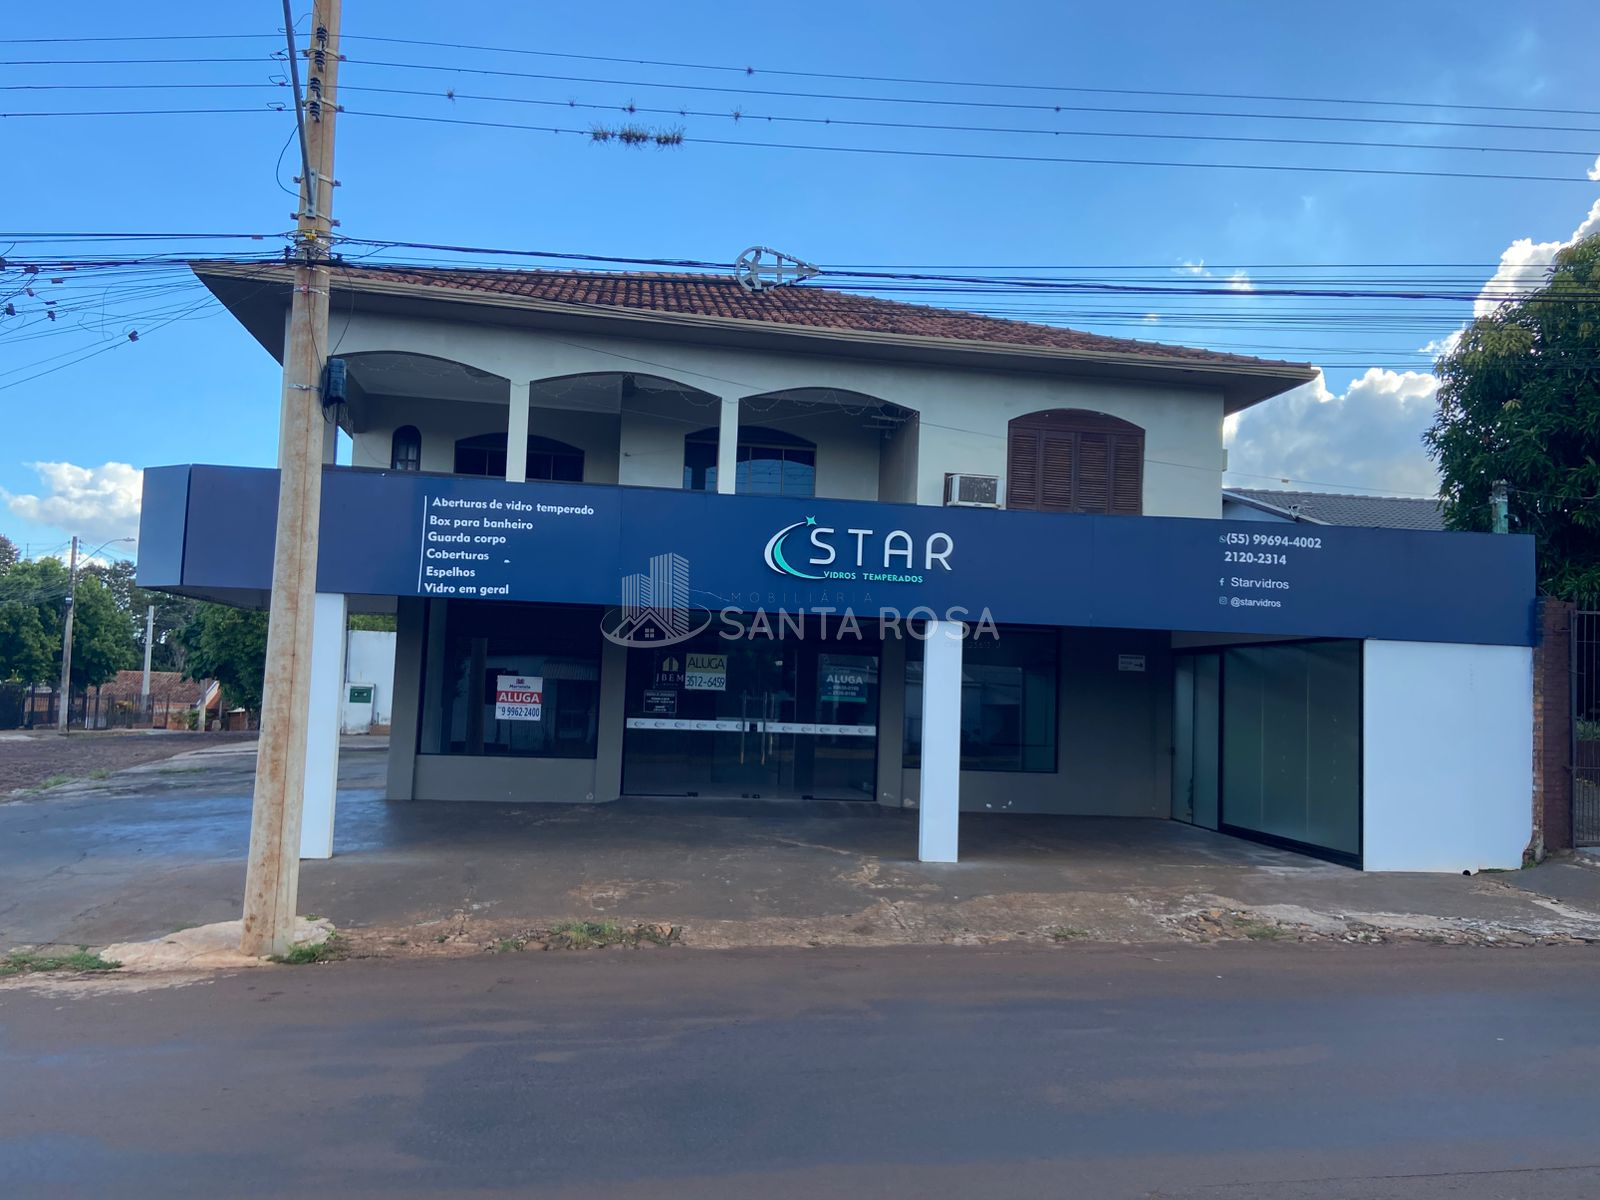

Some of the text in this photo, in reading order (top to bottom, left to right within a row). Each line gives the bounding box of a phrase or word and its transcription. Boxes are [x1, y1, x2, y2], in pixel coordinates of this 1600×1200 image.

[432, 497, 595, 515] Aberturas de vidro temperado
[430, 515, 534, 530] Box para banheiro
[427, 532, 507, 546] Guarda corpo
[1226, 533, 1322, 549] (55) 99694-4002
[426, 548, 490, 560] Coberturas
[809, 528, 955, 572] STAR
[1224, 551, 1287, 565] 2120-2314
[425, 566, 476, 578] Espelhos
[823, 571, 924, 584] VIDROS TEMPERADOS
[424, 582, 510, 596] Vidro em geral
[1230, 577, 1290, 590] Starvidros
[1230, 596, 1282, 608] @starvidros
[687, 656, 725, 670] ALUGA
[826, 674, 863, 685] ALUGA
[498, 692, 540, 703] ALUGA
